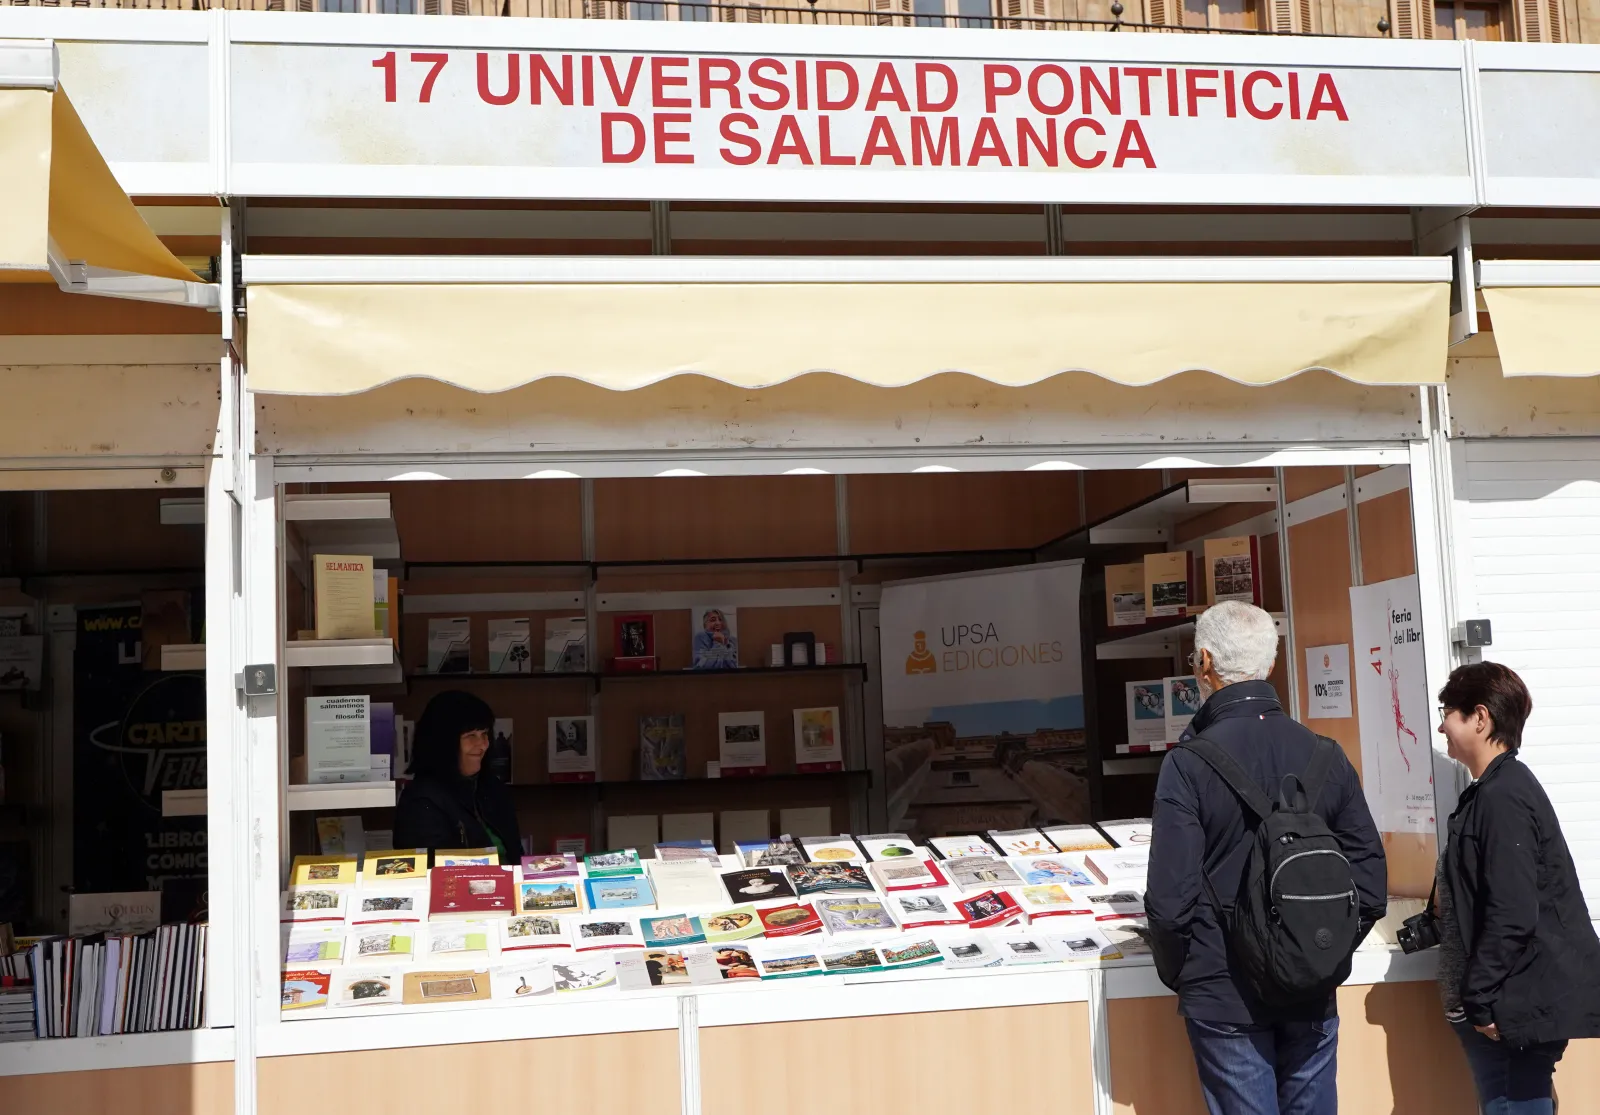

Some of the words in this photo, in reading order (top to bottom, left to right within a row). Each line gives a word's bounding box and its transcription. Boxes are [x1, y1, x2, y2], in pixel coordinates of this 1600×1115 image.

[372, 51, 449, 103] 17
[476, 53, 959, 113] UNIVERSIDAD
[983, 63, 1349, 122] PONTIFICIA
[600, 112, 695, 164] DE
[719, 112, 1157, 169] SALAMANCA
[1392, 608, 1411, 623] feria
[941, 622, 999, 647] UPSA
[1394, 629, 1404, 645] del
[943, 641, 1063, 672] EDICIONES
[1314, 683, 1328, 697] 10%
